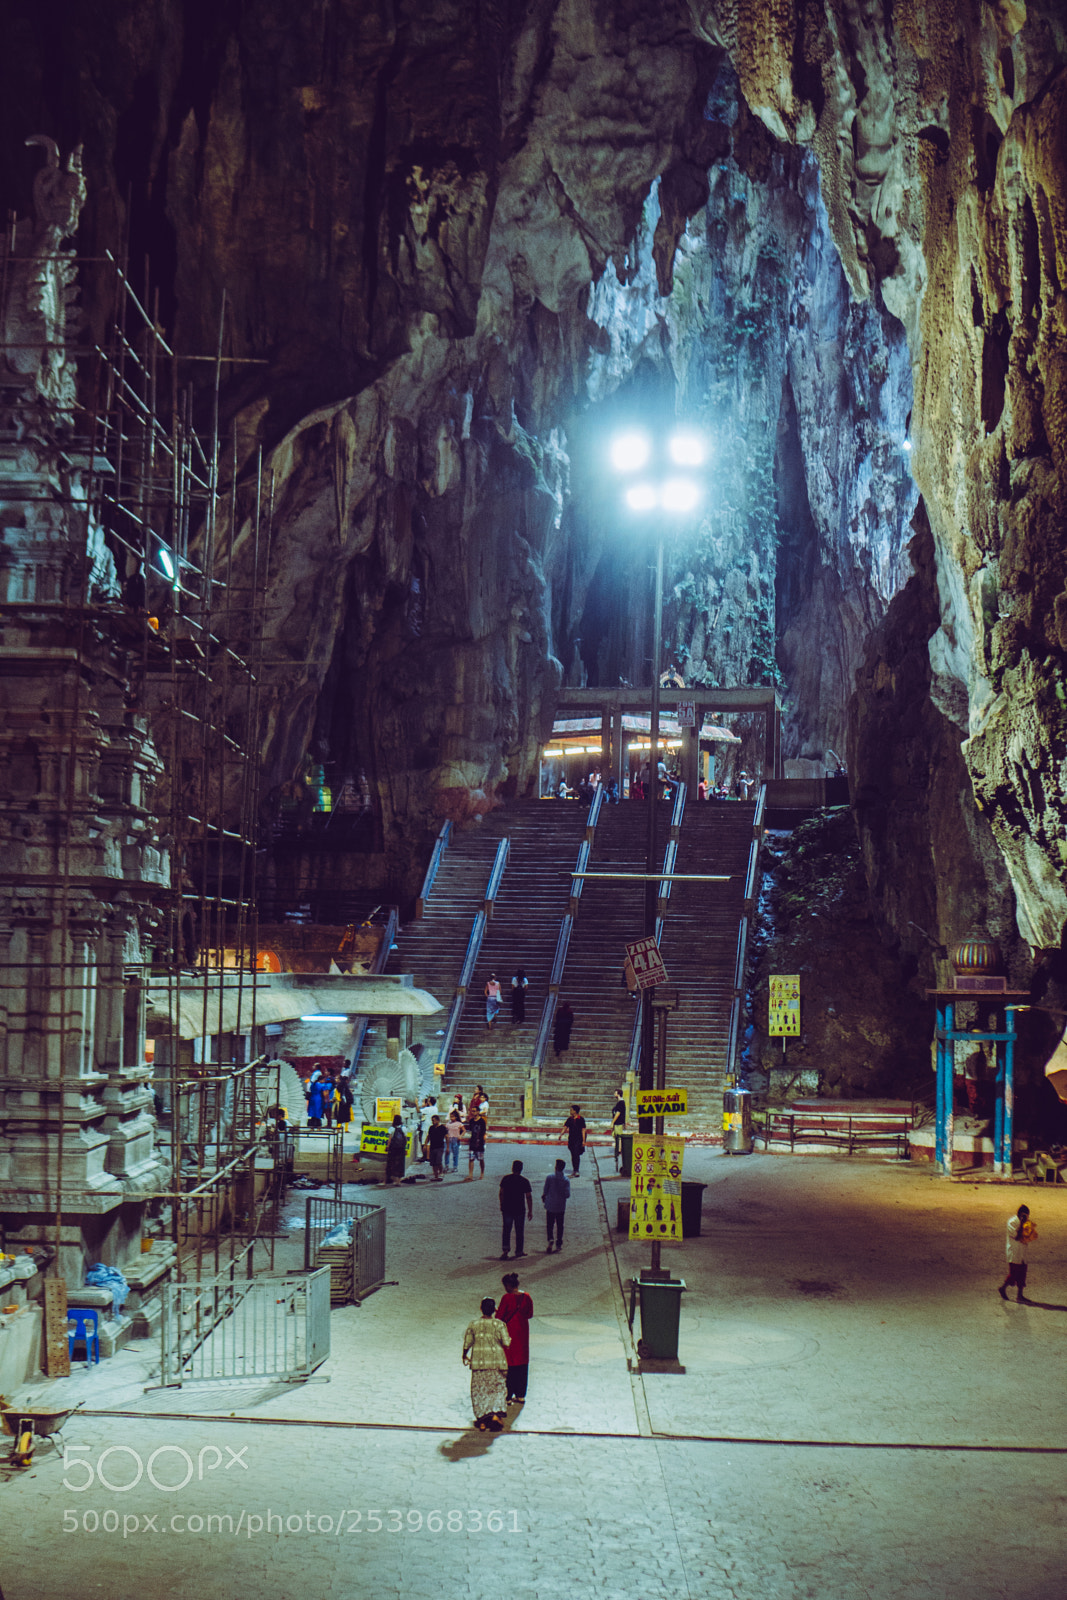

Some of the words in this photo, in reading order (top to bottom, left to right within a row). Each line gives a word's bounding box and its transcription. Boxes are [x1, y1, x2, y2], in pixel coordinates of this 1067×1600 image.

[679, 708, 693, 718] 5A
[629, 939, 656, 955] ZON
[634, 950, 661, 970] 4A
[638, 1103, 685, 1115] KAVADI
